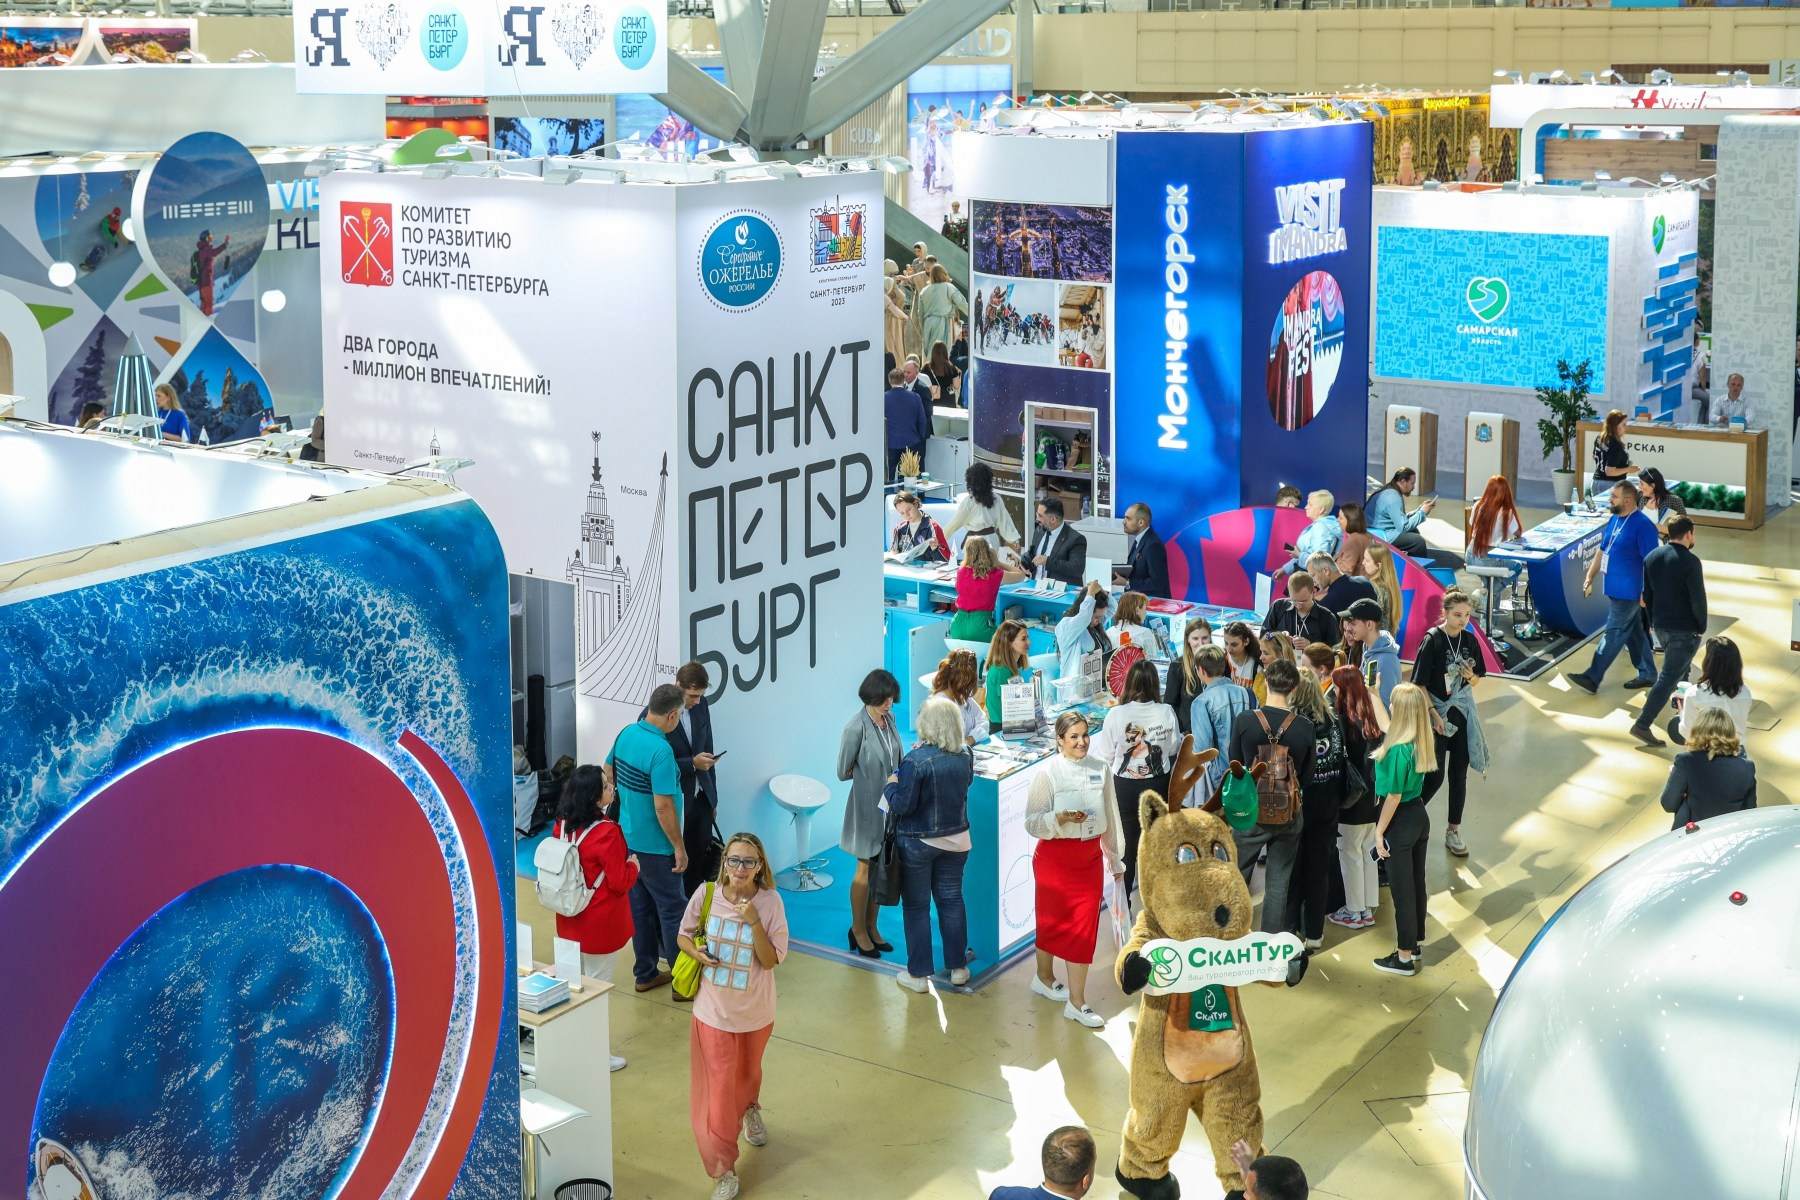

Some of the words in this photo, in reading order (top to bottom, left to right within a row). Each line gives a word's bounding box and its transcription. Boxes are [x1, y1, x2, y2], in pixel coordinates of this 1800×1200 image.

[428, 14, 458, 28] САНКТ
[621, 16, 647, 30] САНКТ
[428, 29, 459, 43] ПЕТЕР
[621, 31, 648, 44] ПЕТЕР
[429, 45, 453, 59] БУРГ
[621, 45, 643, 59] БУРГ
[850, 128, 881, 145] CUBA
[401, 205, 471, 225] КОМИТЕТ
[1274, 178, 1346, 234] VISIT
[402, 226, 423, 244] ПО
[428, 229, 512, 250] РАЗВИТИЮ
[1269, 226, 1349, 264] IMANDRA
[402, 248, 471, 268] ТУРИЗМА
[709, 262, 774, 285] ОЖЕРЕЛЬЕ
[402, 269, 550, 297] САНКТ-ПЕТЕРБУРГА
[728, 282, 756, 294] РОССИИ
[809, 283, 867, 299] САНКТ-ПЕТЕРБУРГ
[831, 297, 846, 307] 2023
[1157, 184, 1196, 450] Мончегорск
[1283, 306, 1322, 347] IMANDRA
[1456, 324, 1519, 338] САМАРСКАЯ
[343, 335, 374, 354] ДВА
[378, 338, 439, 361] ГОРОДА
[1288, 327, 1317, 379] FEST
[352, 359, 426, 382] МИЛЛИОН
[431, 367, 551, 396] ВПЕЧАТЛЕНИЙ!
[687, 339, 871, 469] САНКТ
[353, 449, 406, 464] Санкт-Петербург
[1626, 442, 1665, 454] РСКАЯ
[620, 485, 648, 497] Москва
[688, 452, 873, 593] ПЕТЕР
[689, 568, 841, 707] БУРГ
[1187, 973, 1204, 981] Ваш
[1205, 968, 1255, 981] туроператор
